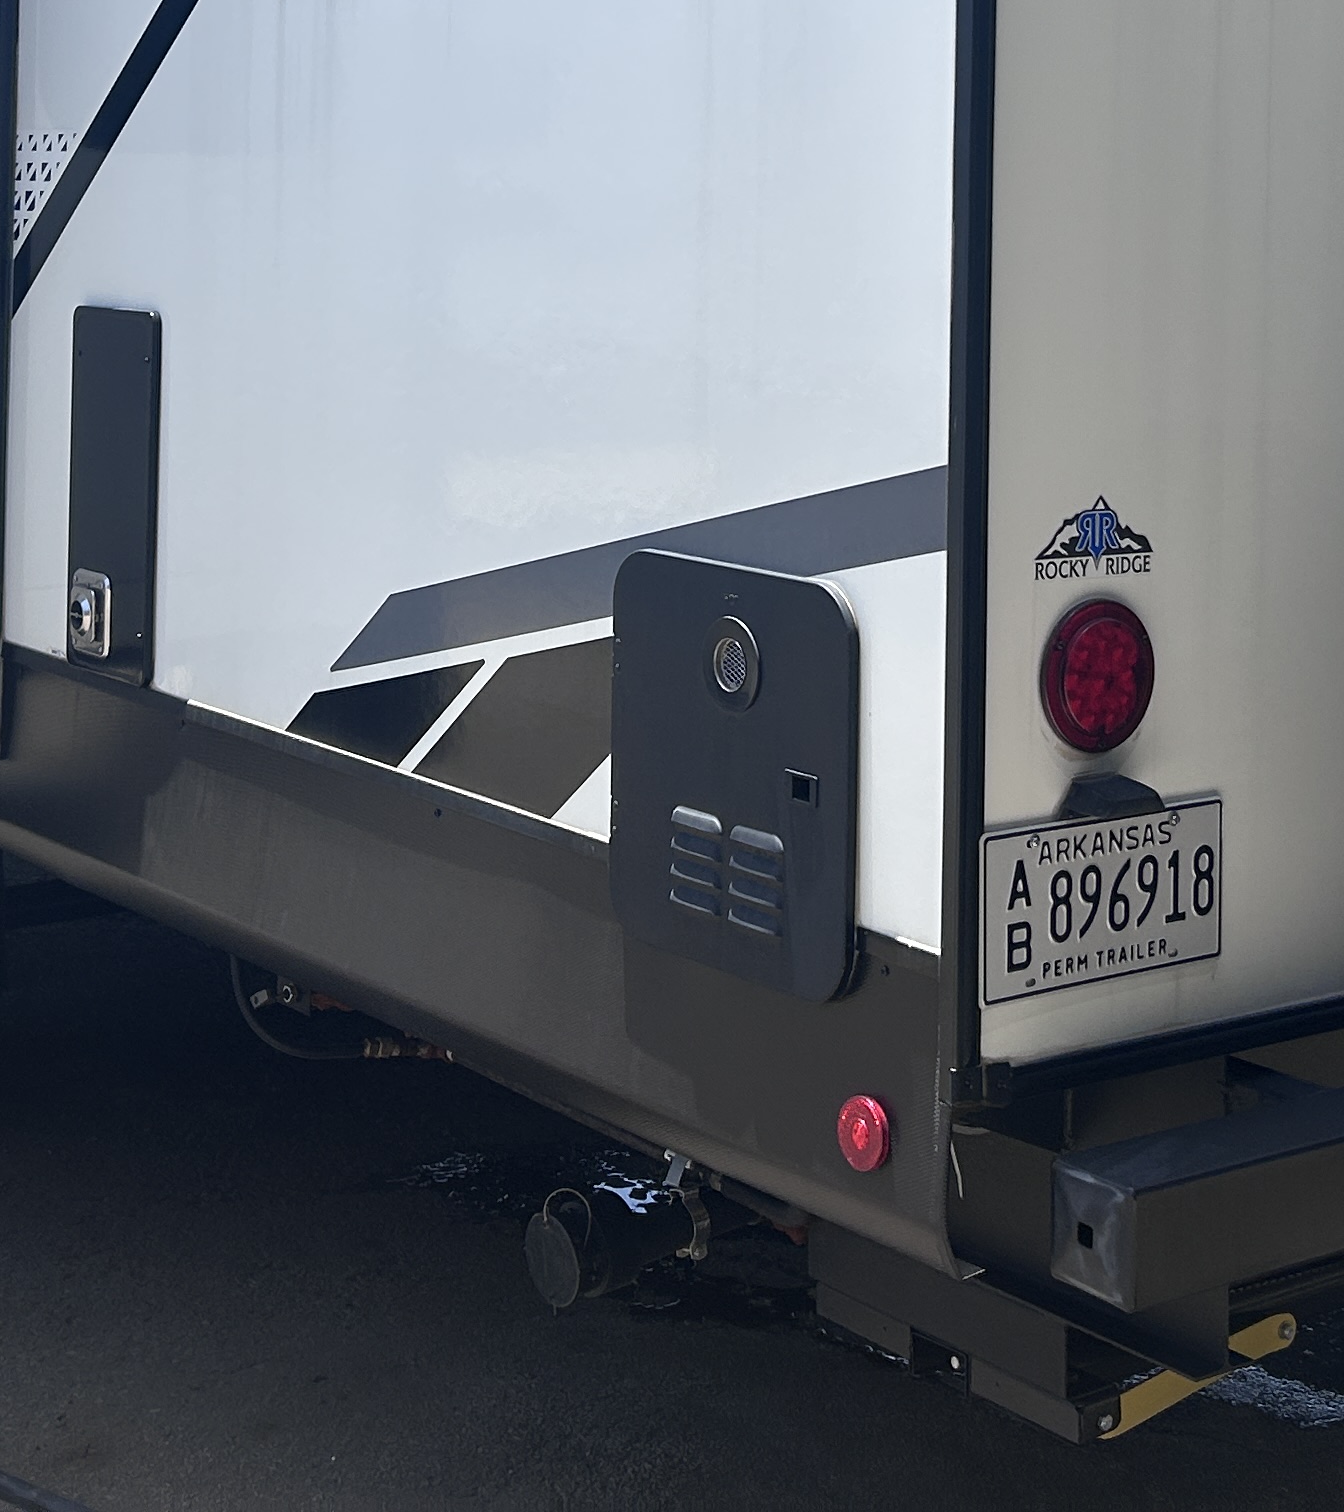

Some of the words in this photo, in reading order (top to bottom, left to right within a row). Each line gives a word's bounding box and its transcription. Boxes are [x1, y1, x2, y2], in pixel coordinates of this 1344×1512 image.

[1035, 558, 1090, 580] ROCKY
[1105, 555, 1151, 575] RIDGE
[1038, 821, 1172, 866] ARKANSAS
[1050, 844, 1215, 944] 896918
[1042, 954, 1089, 980] PERM
[1096, 938, 1167, 968] TRAILER
